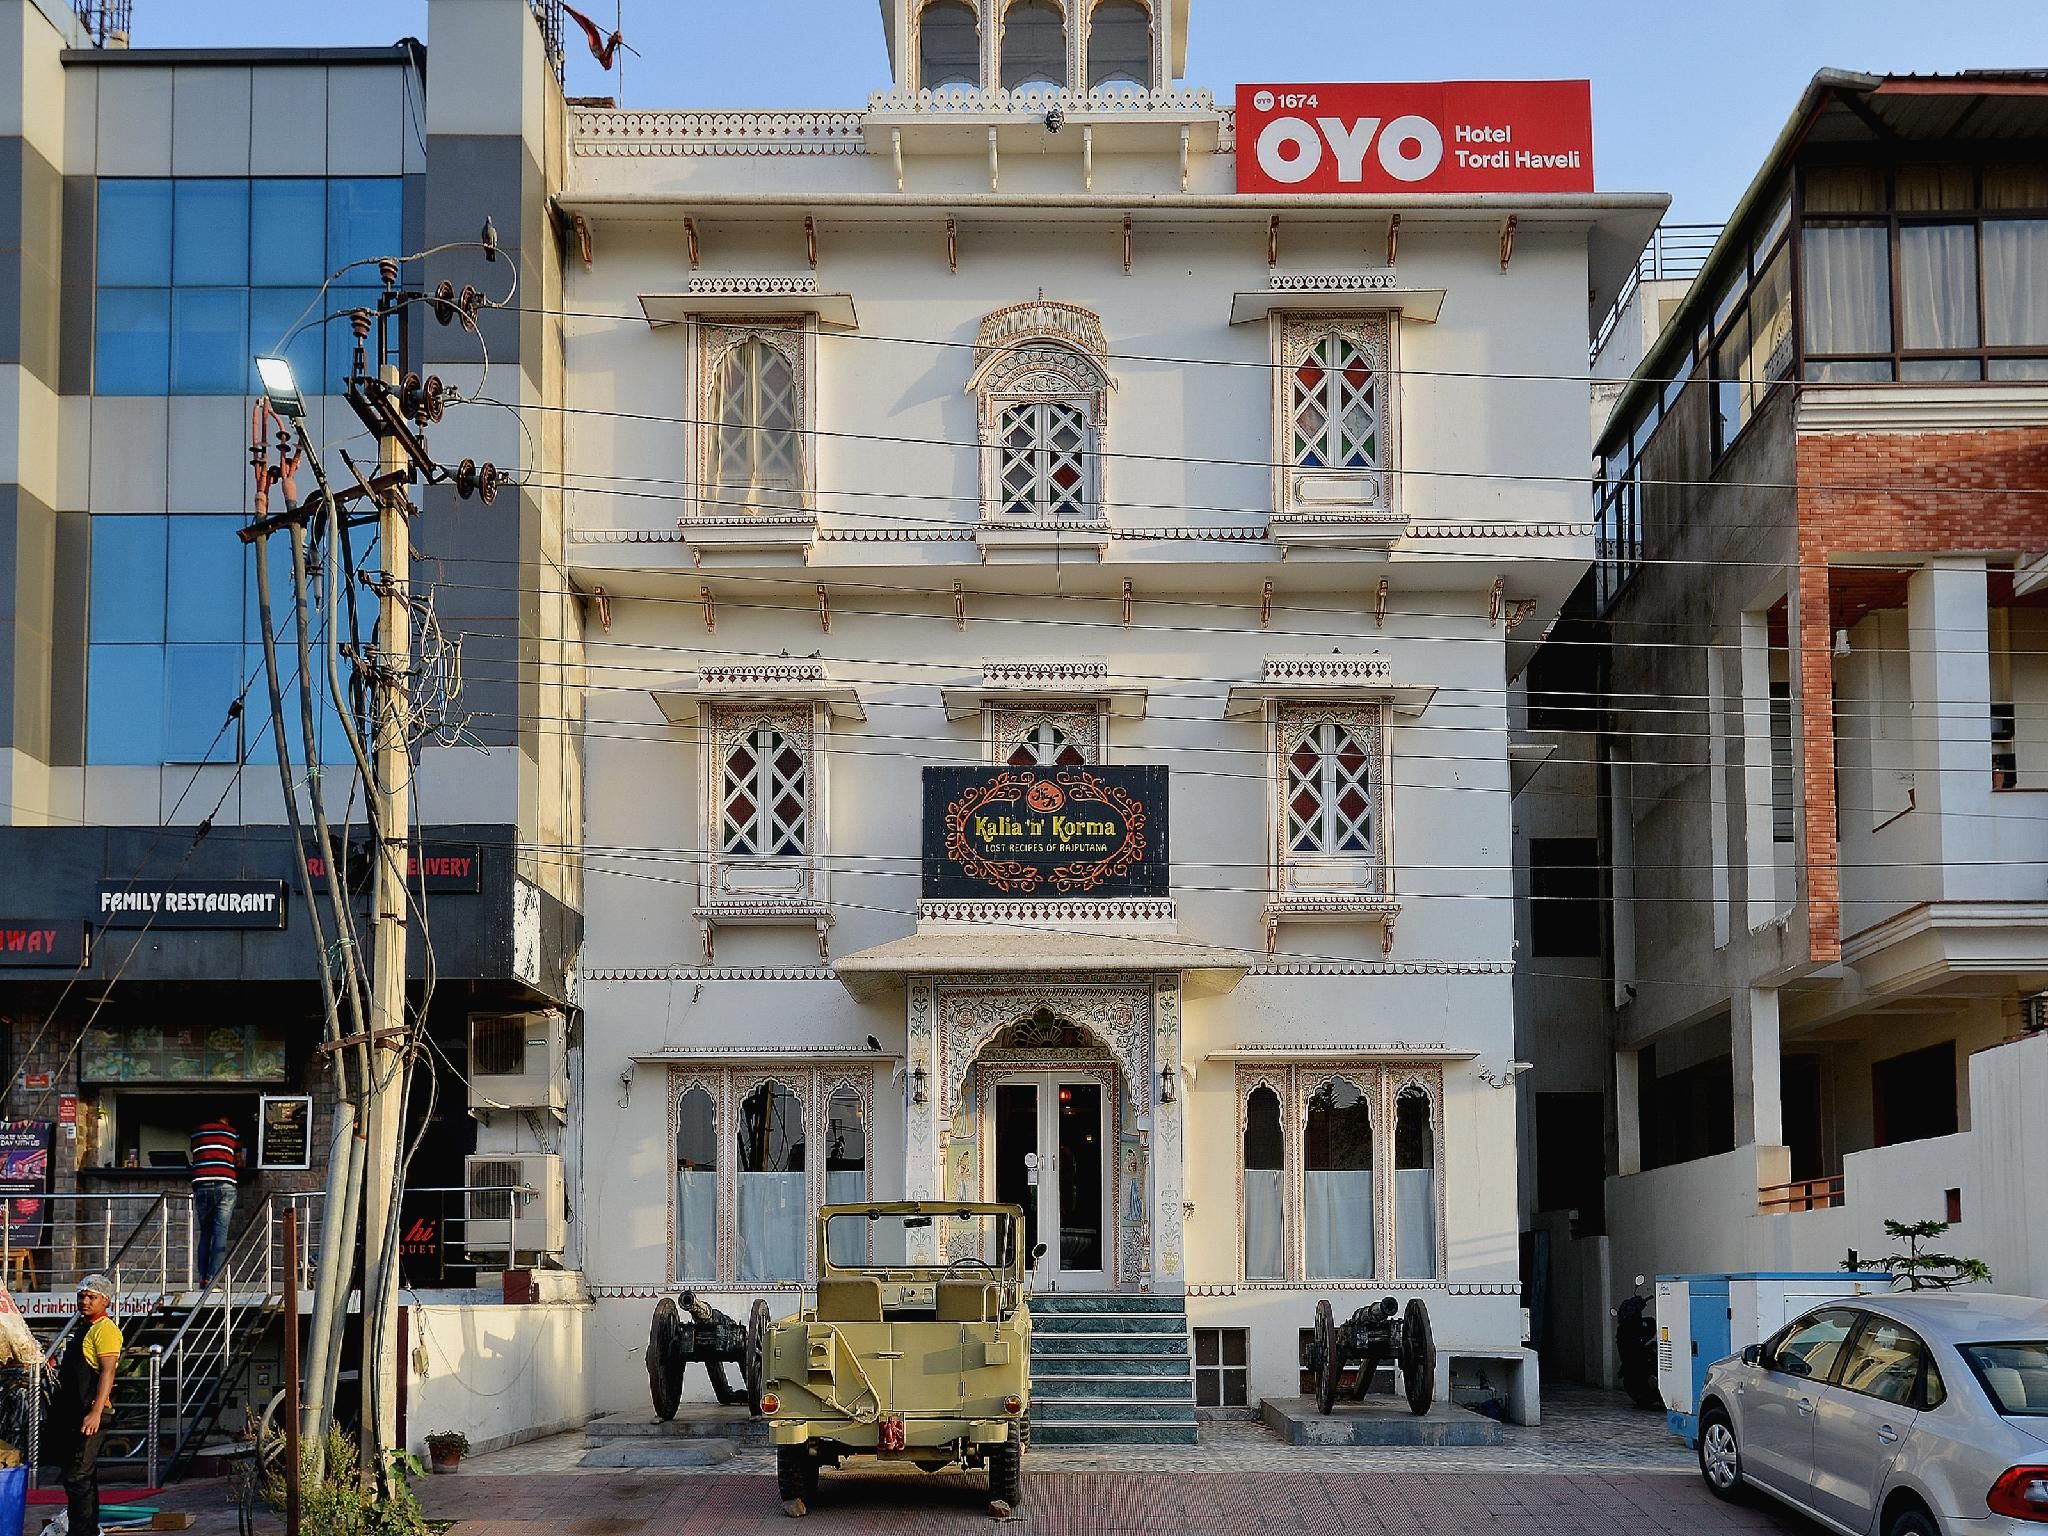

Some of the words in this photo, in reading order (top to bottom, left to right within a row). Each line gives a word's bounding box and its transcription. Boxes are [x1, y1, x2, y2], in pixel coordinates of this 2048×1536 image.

[1278, 94, 1319, 109] 1674
[1455, 125, 1511, 143] Hotel
[1256, 115, 1443, 183] OYO
[1455, 150, 1510, 168] Tordi
[1515, 150, 1581, 168] Haveli
[975, 816, 1023, 843] Kalia
[1052, 816, 1117, 843] Korma
[985, 843, 1006, 853] LOST
[1009, 843, 1044, 853] RECIPES
[1046, 843, 1058, 853] OF
[1060, 843, 1108, 853] RAJPUTANA
[407, 857, 471, 877] EIVERY
[101, 892, 162, 913] FAMILY
[165, 892, 276, 913] RESTAURANT
[399, 1245, 436, 1255] QUET
[33, 1298, 77, 1314] drinkin
